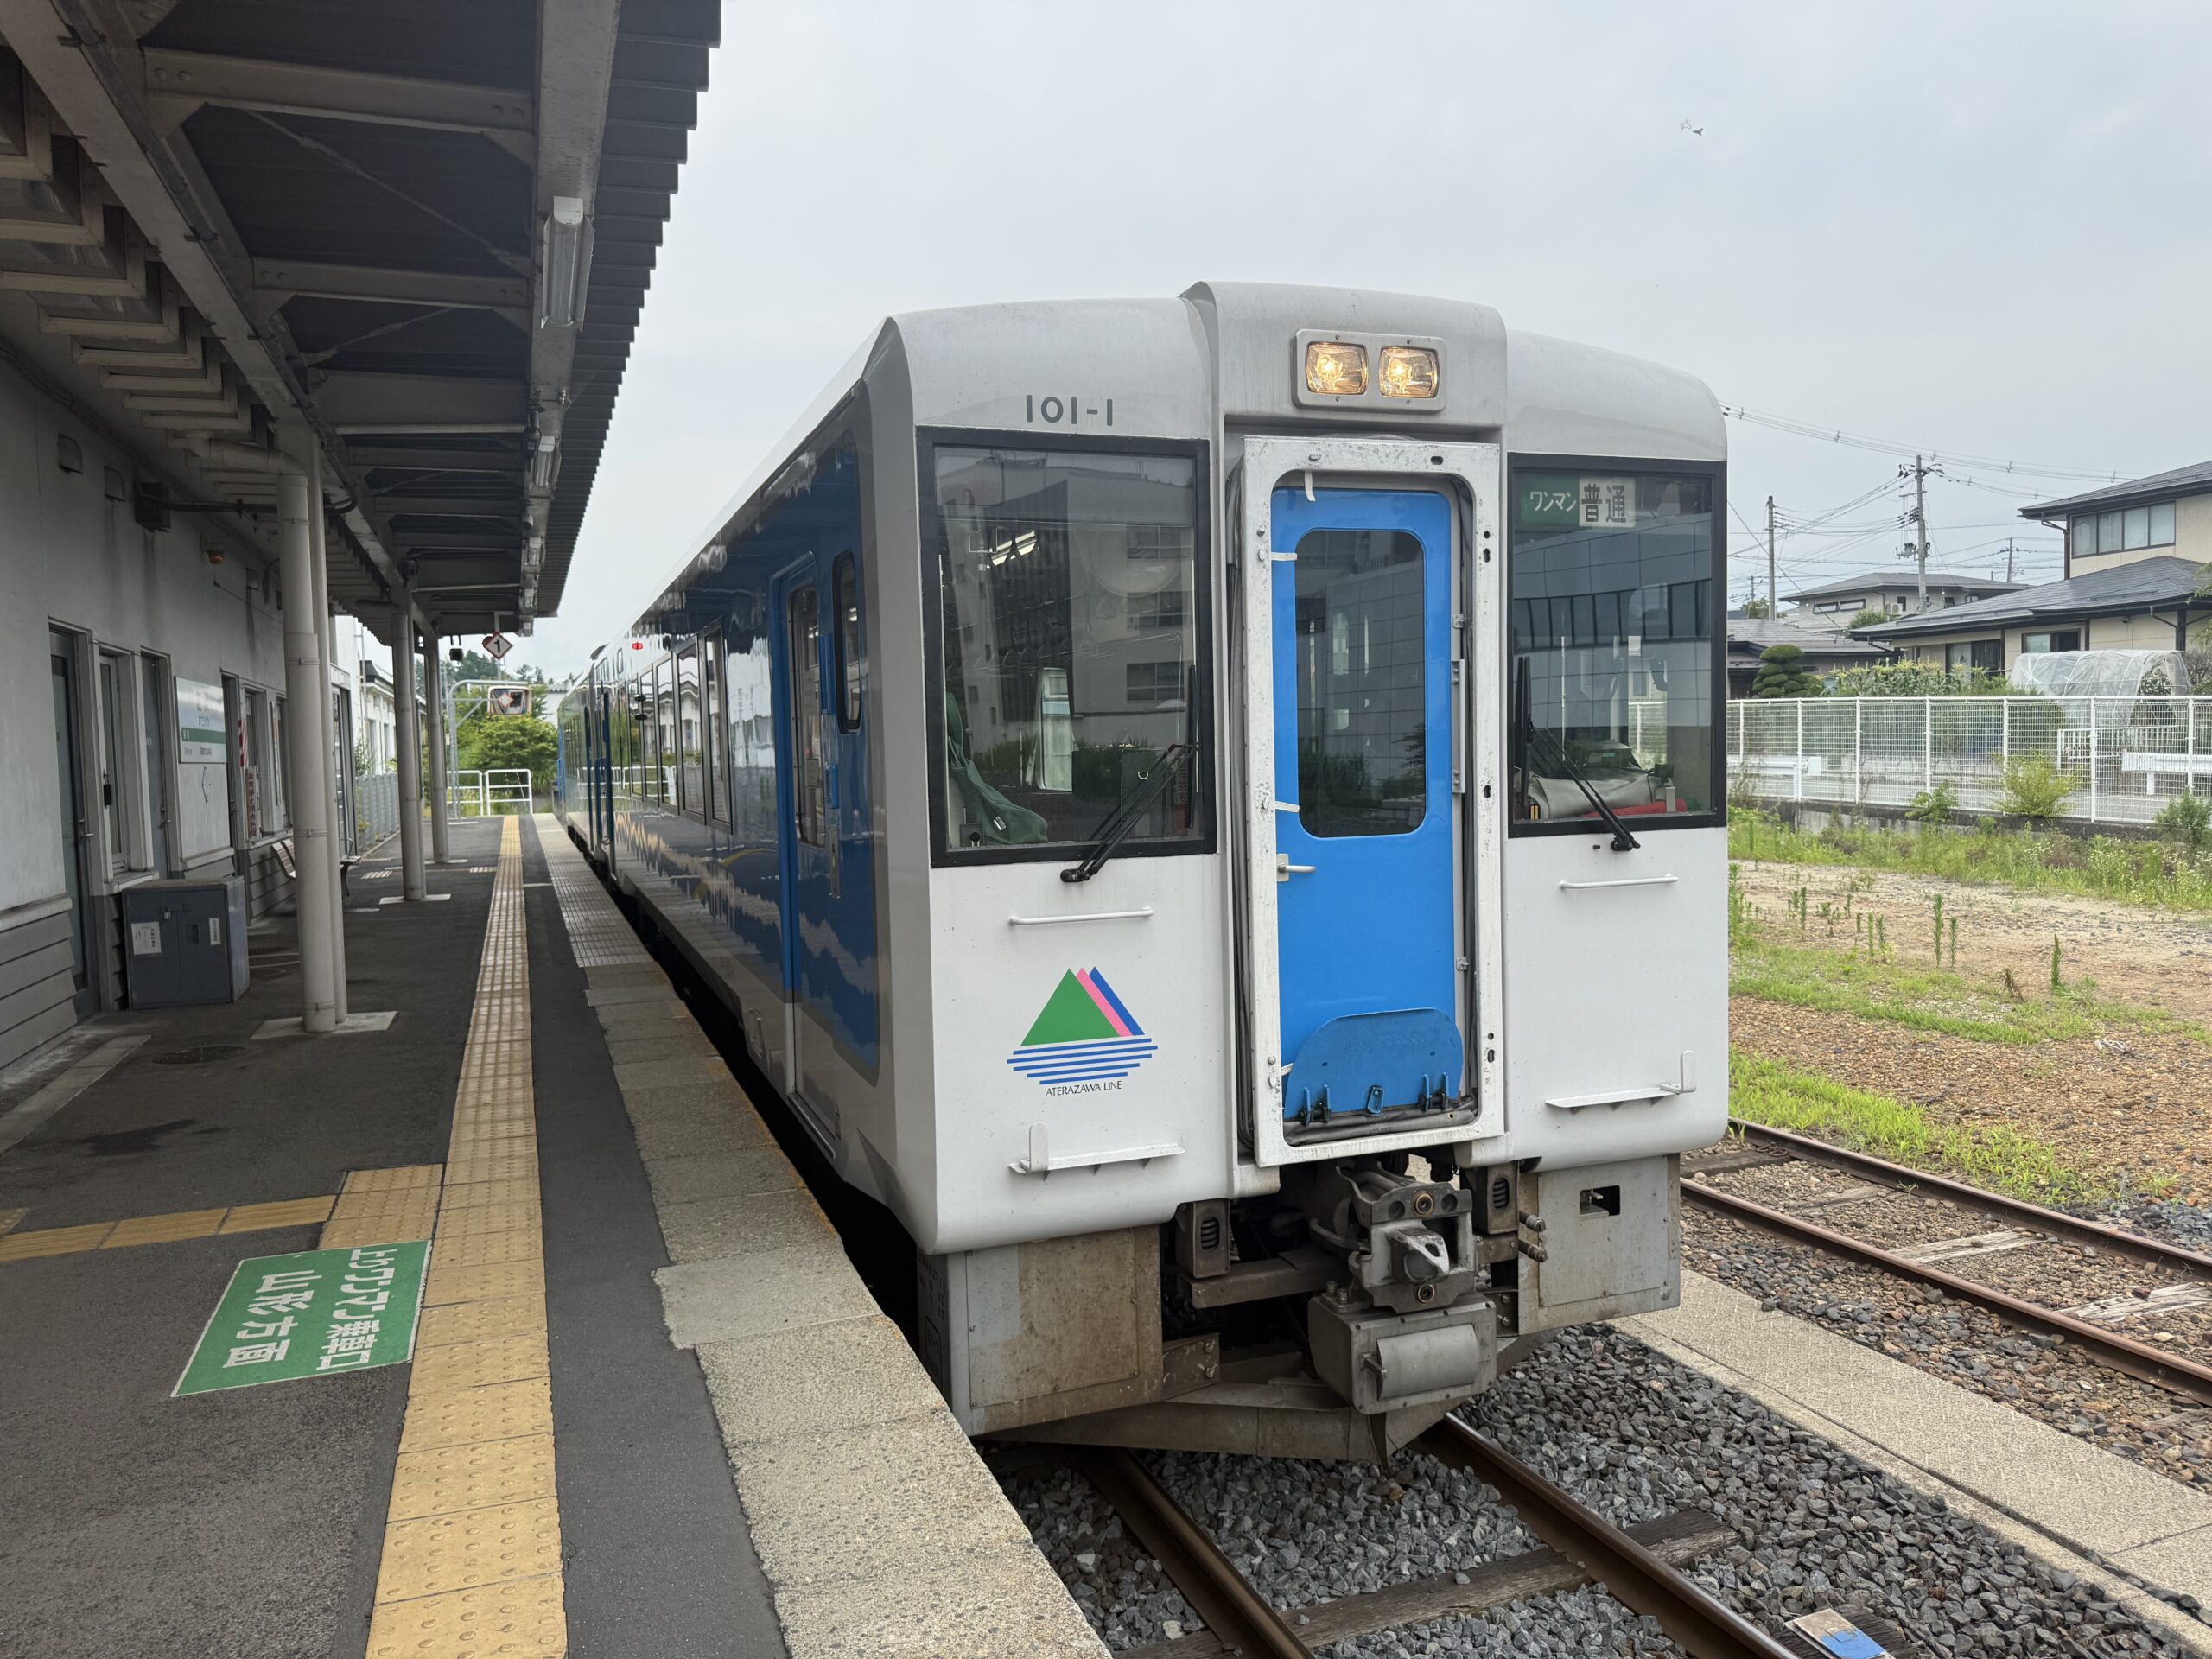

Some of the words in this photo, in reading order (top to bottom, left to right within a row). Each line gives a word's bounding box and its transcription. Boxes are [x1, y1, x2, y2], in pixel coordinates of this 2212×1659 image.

[1026, 394, 1113, 426] 101-1
[1529, 490, 1577, 512] ワンマン
[1581, 482, 1627, 523] 普通
[493, 639, 501, 652] 1
[1046, 1084, 1101, 1096] ATERAZAWA
[1103, 1081, 1122, 1090] LINE
[221, 1269, 323, 1369] 山形方面
[316, 1248, 398, 1371] 上りワンマン乗車口
